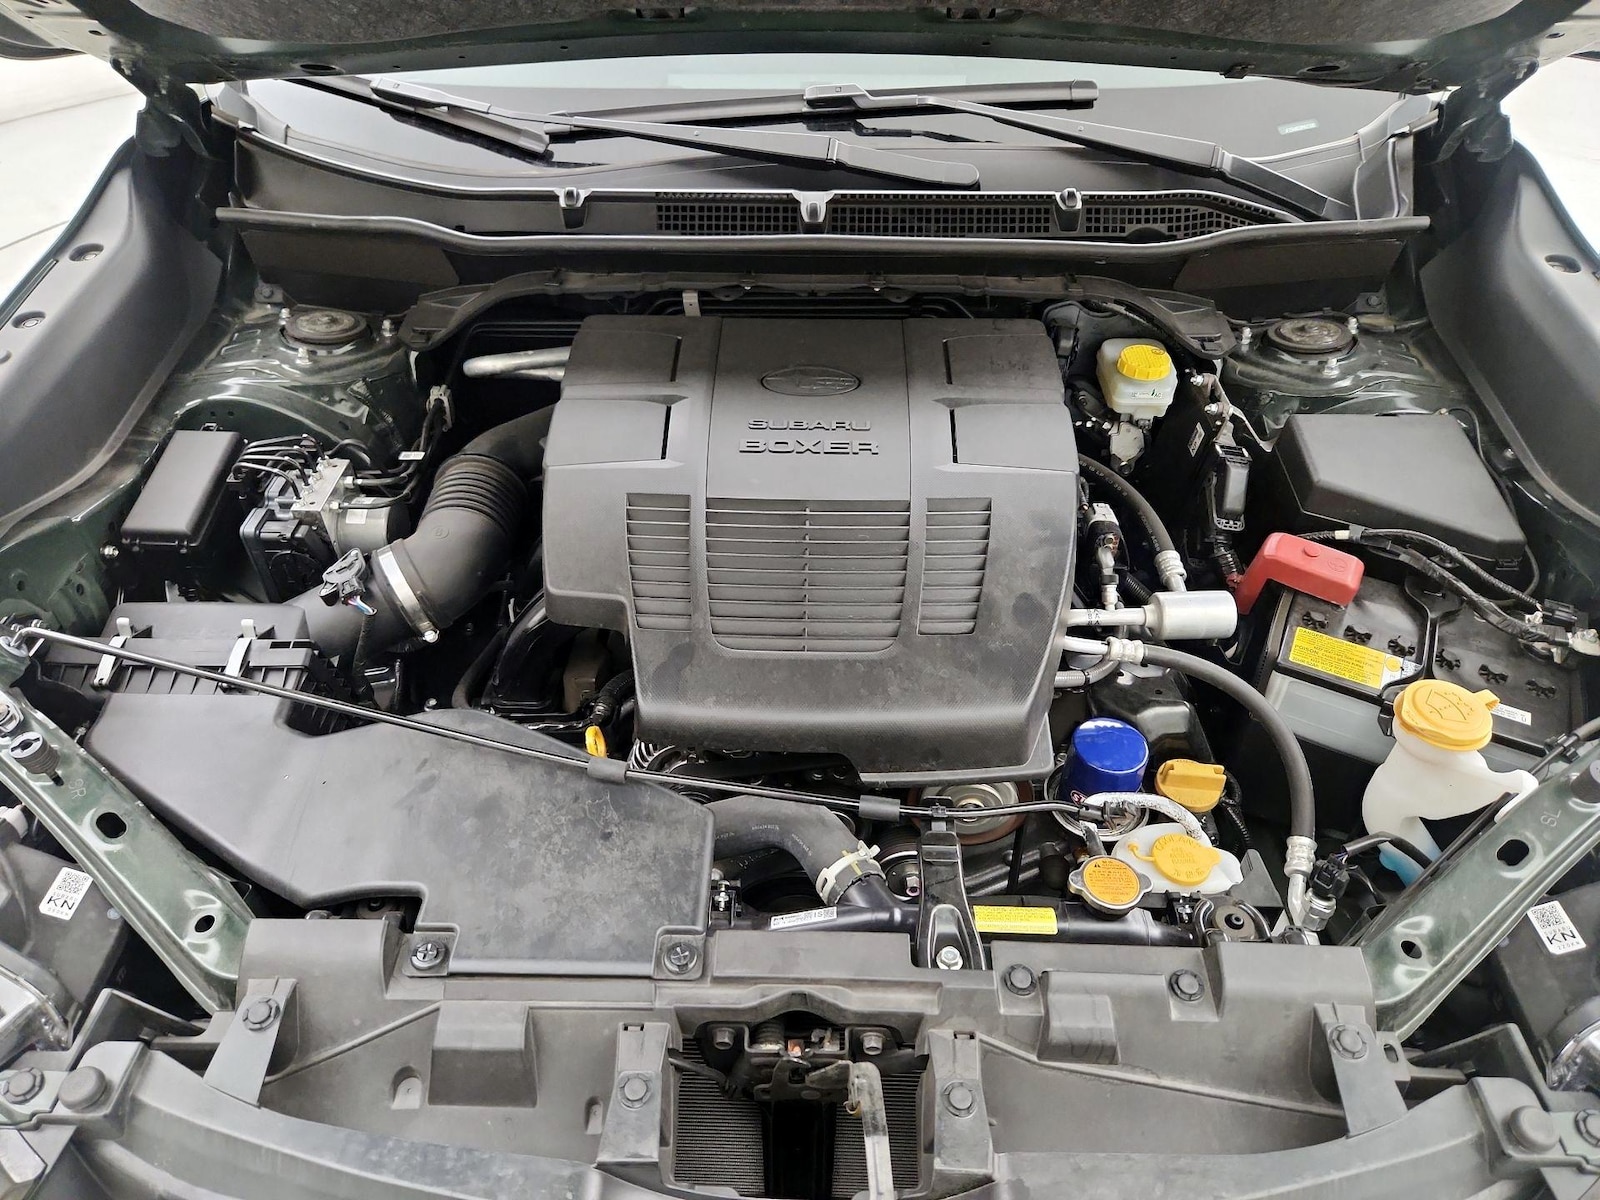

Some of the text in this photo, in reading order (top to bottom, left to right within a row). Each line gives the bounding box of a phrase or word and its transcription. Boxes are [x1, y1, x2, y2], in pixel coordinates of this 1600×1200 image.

[748, 417, 871, 431] SUBARU
[739, 438, 879, 455] BOXER
[47, 895, 75, 910] KN
[1546, 929, 1576, 945] KN
